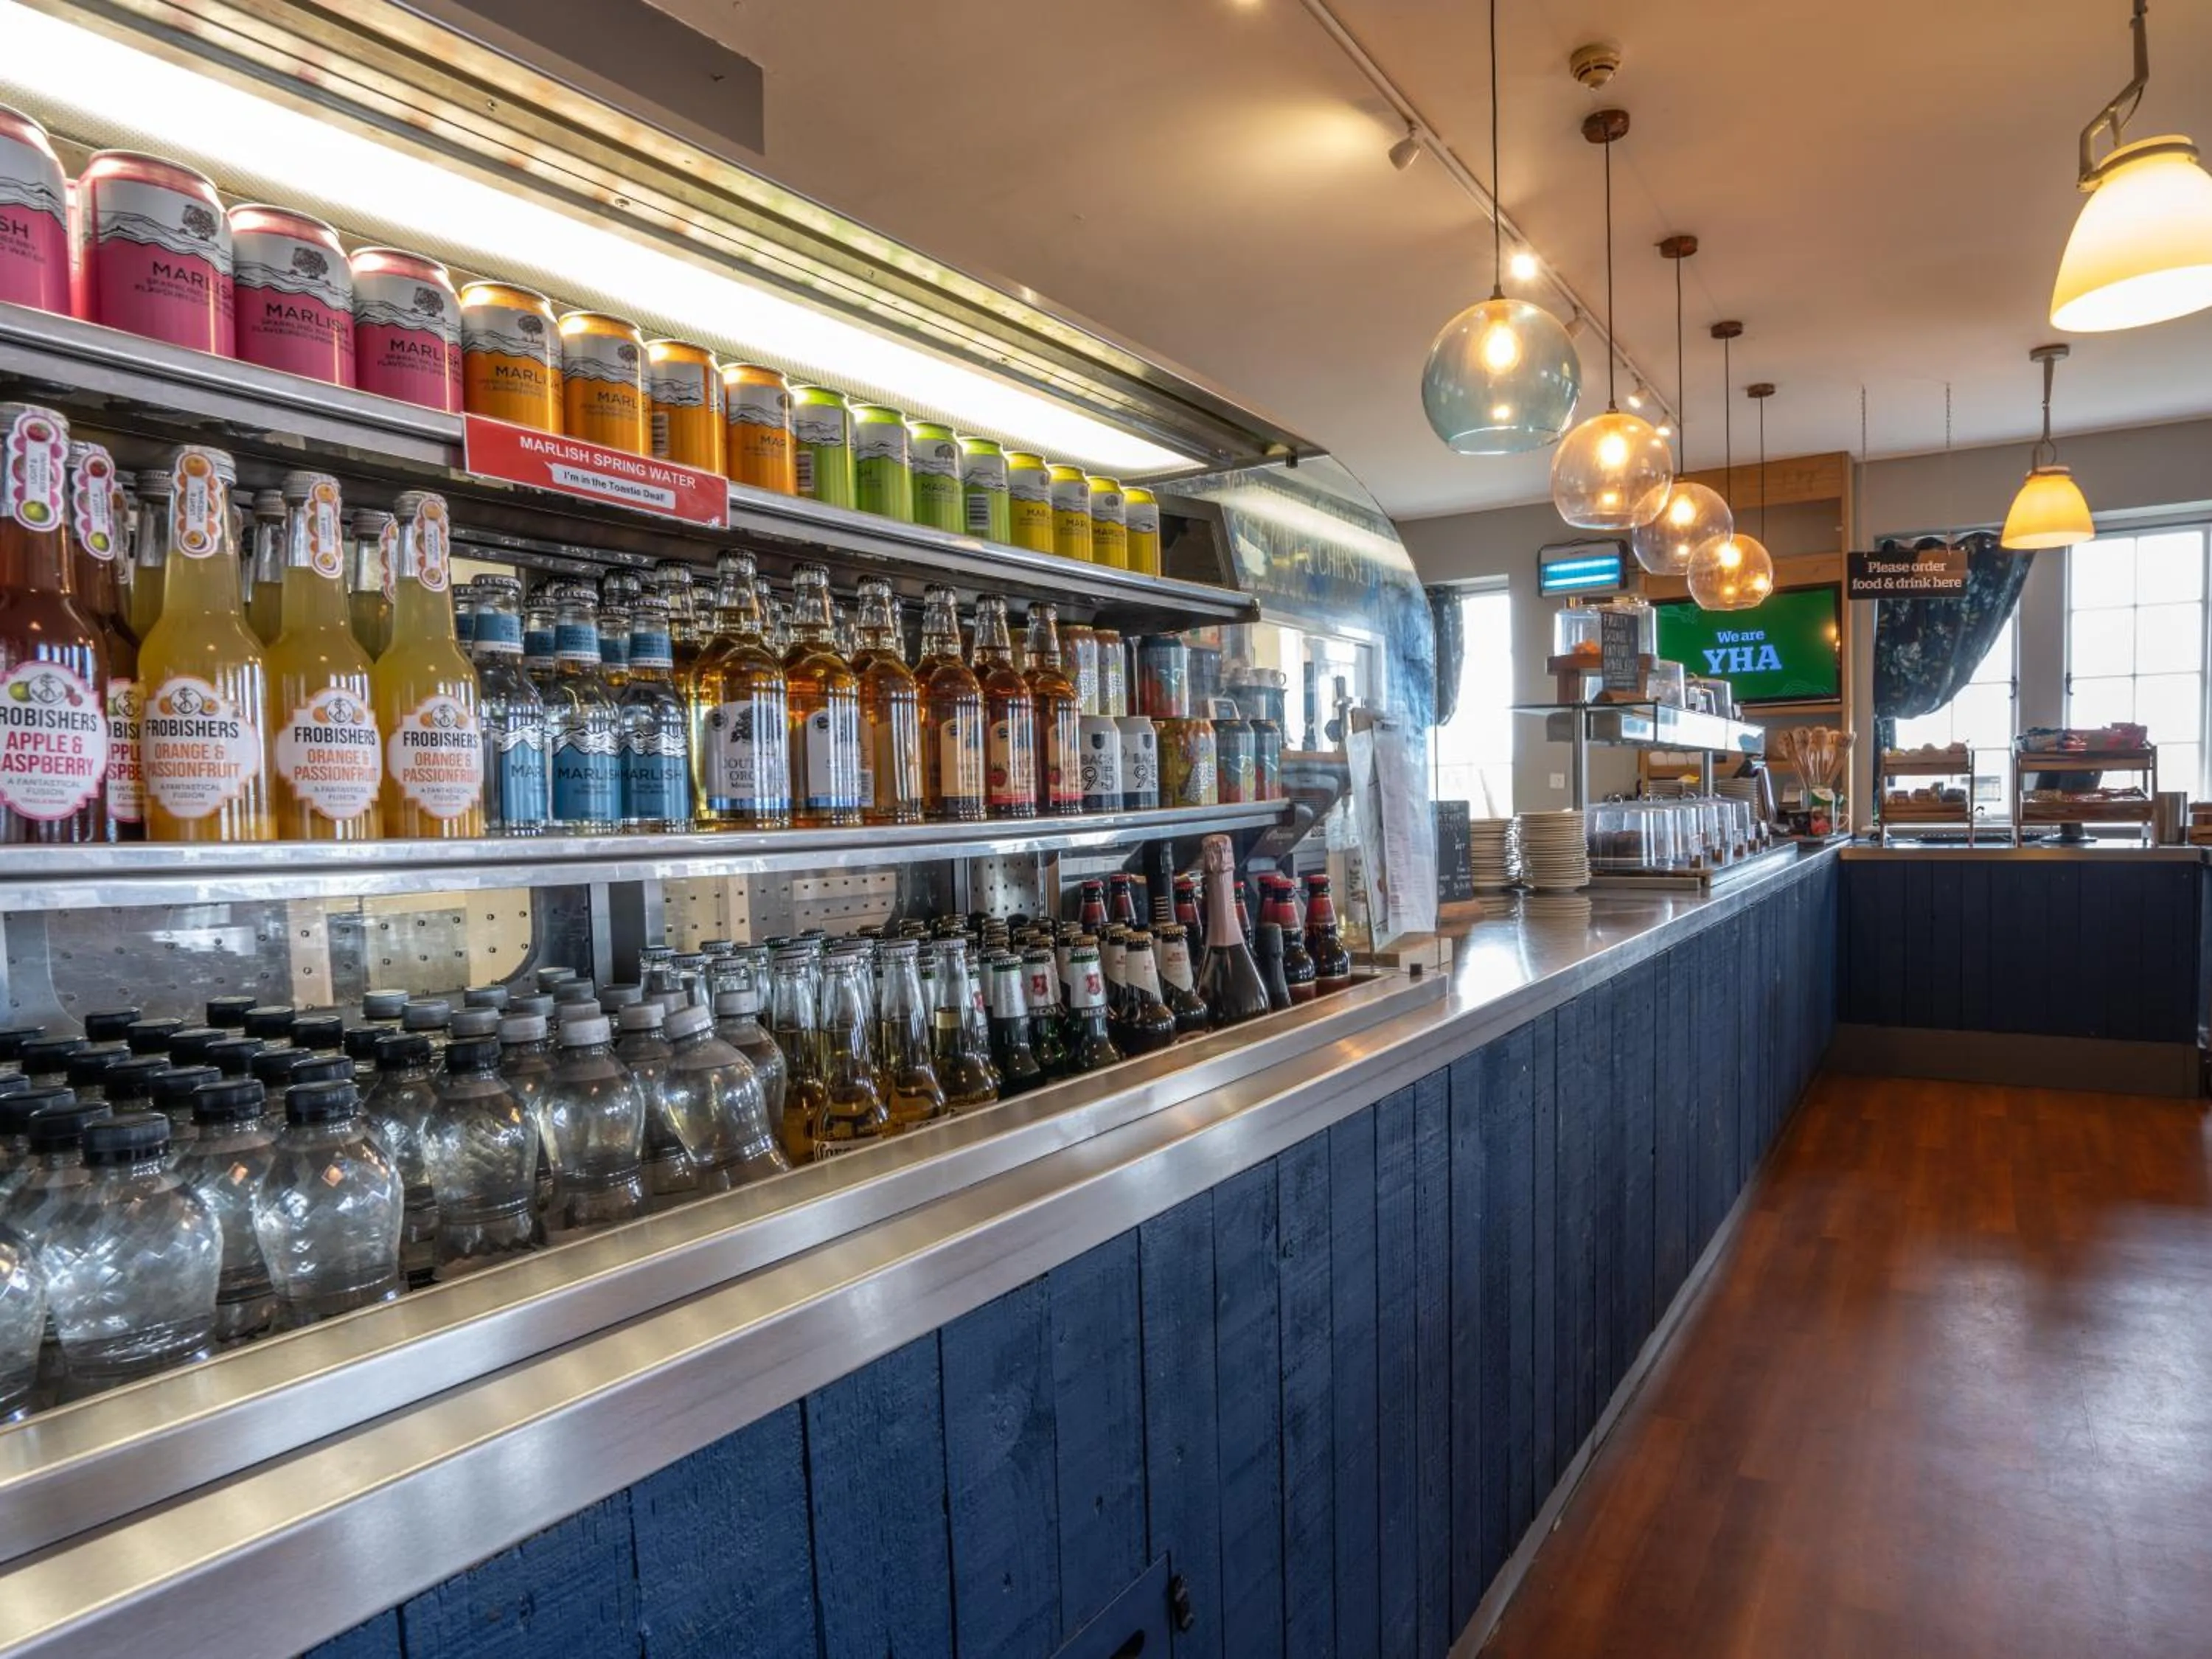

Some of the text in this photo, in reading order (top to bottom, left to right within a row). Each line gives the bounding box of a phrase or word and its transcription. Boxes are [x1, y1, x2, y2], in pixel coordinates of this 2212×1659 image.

[519, 436, 696, 489] MARLISH SPRING WATER
[563, 471, 580, 483] I'm
[580, 474, 591, 484] in
[591, 476, 608, 489] the
[609, 481, 641, 498] Toastie
[1868, 560, 1947, 573] Please order
[1852, 577, 1962, 590] food & drink here
[1717, 630, 1764, 643] We are
[1703, 644, 1782, 674] YHA
[0, 706, 97, 732] ROBISHERS
[146, 719, 239, 739] FROBISHERS
[294, 726, 376, 745] FROBISHERS
[7, 731, 83, 754] APPLE &
[403, 731, 478, 748] FROBISHERS
[155, 743, 224, 760] ORANGE &
[307, 748, 360, 765] ORANGE
[415, 752, 463, 766] ORANGE
[1, 753, 94, 776] ASPBERRY
